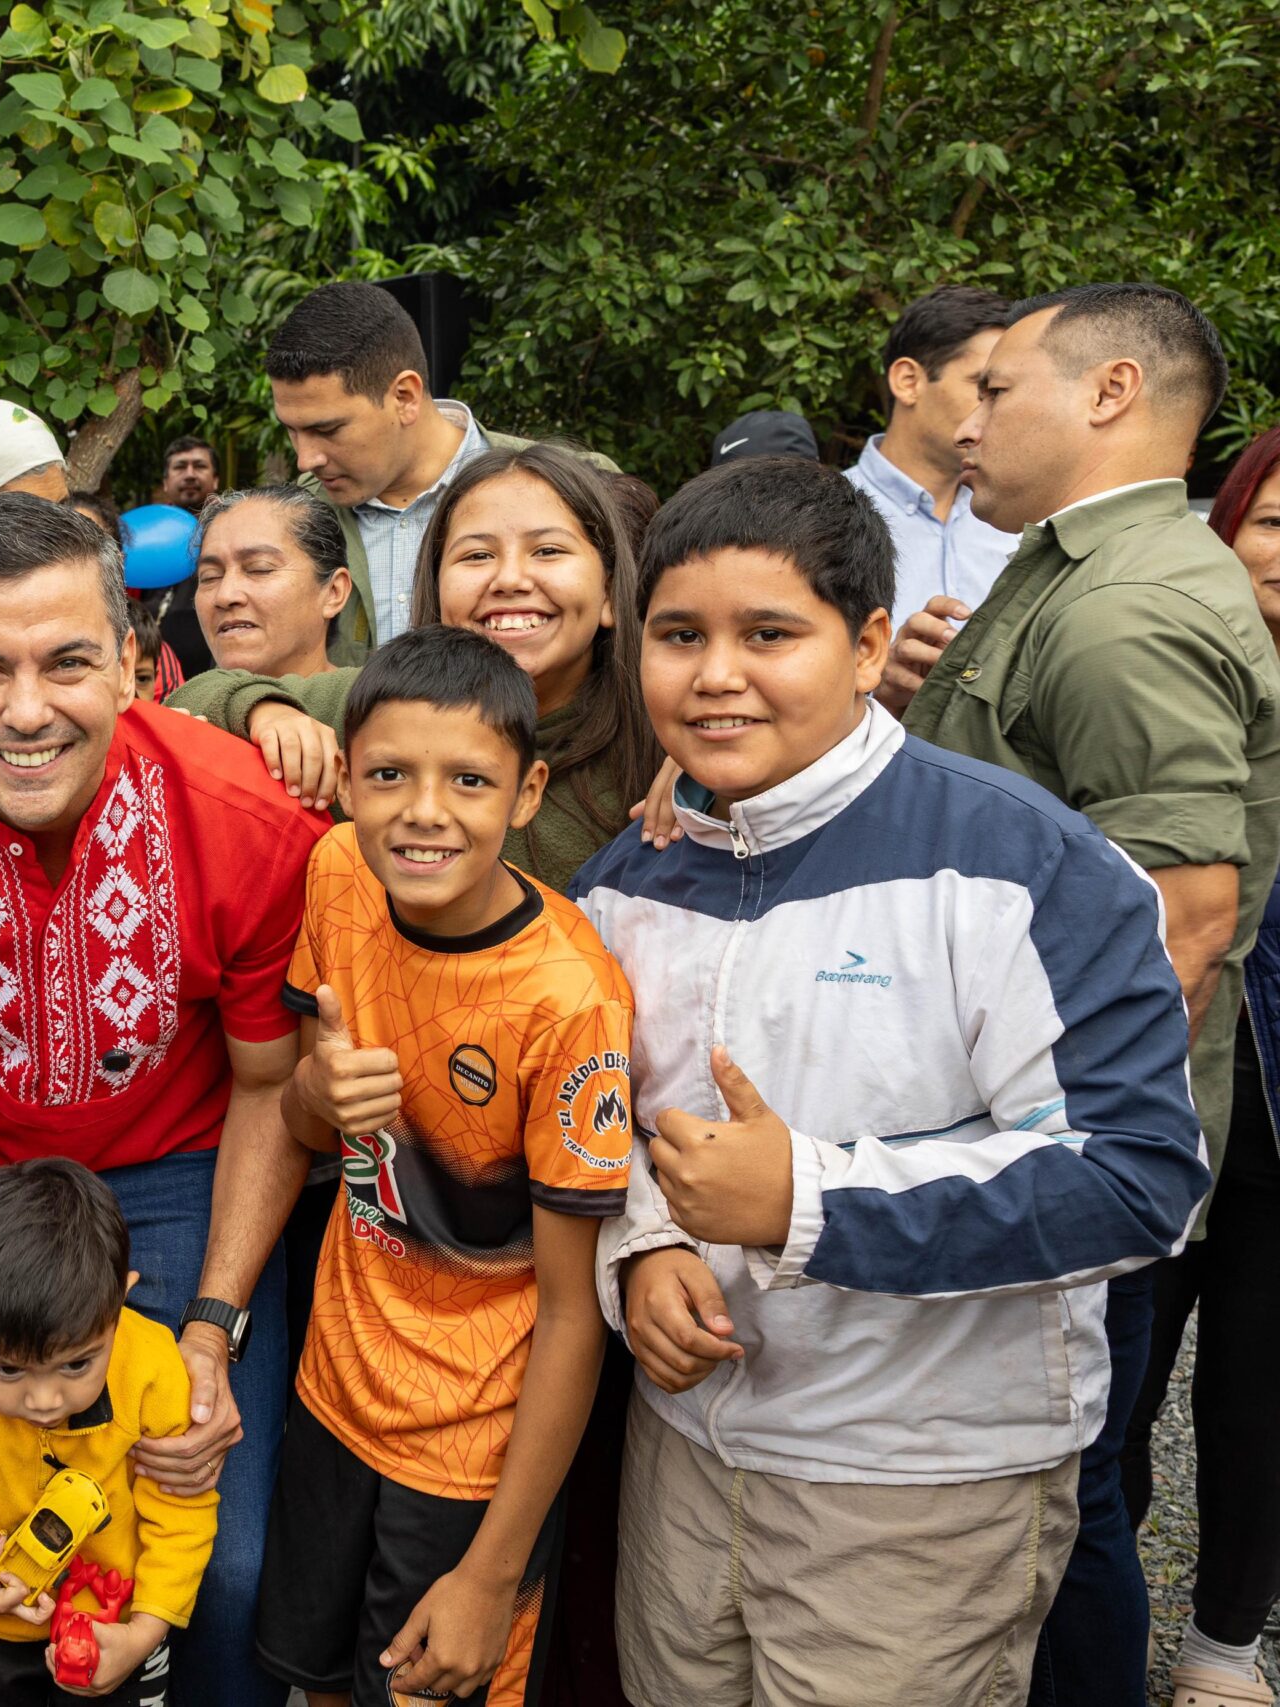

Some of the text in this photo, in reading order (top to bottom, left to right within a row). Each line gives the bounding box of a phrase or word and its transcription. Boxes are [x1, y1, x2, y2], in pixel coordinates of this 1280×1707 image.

[815, 970, 892, 987] Boomerang
[455, 1063, 490, 1089] DECANITO
[558, 1056, 600, 1105] ASADO
[559, 1109, 572, 1127] EL
[564, 1139, 616, 1168] TRADICIÓN
[346, 1190, 385, 1225] uper
